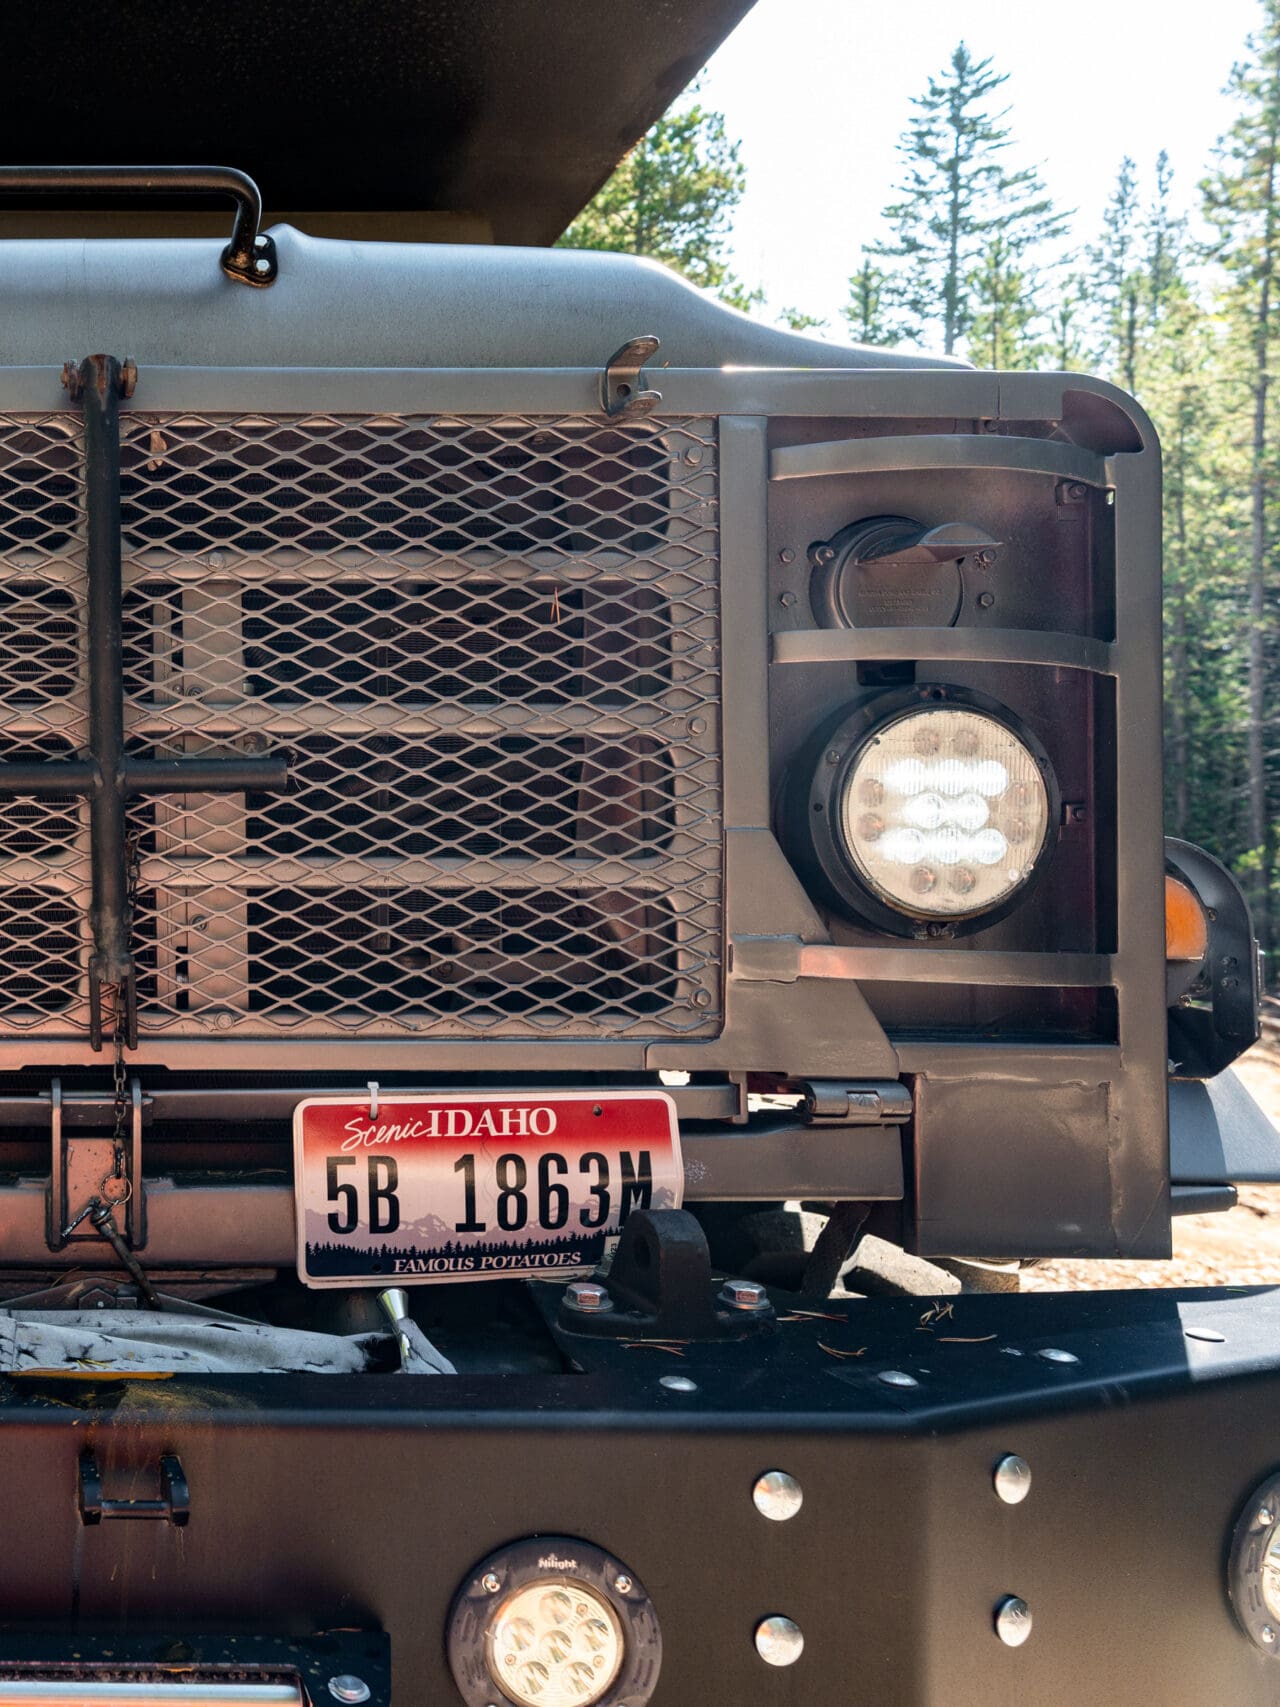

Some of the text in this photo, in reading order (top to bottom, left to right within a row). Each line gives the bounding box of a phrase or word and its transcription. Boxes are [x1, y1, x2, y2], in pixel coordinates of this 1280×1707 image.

[340, 1107, 558, 1151] Scenic IDAHO
[325, 1150, 654, 1235] 5B 1863M
[392, 1252, 582, 1274] FAMOUS POTATOES
[539, 1555, 577, 1569] Nilight
